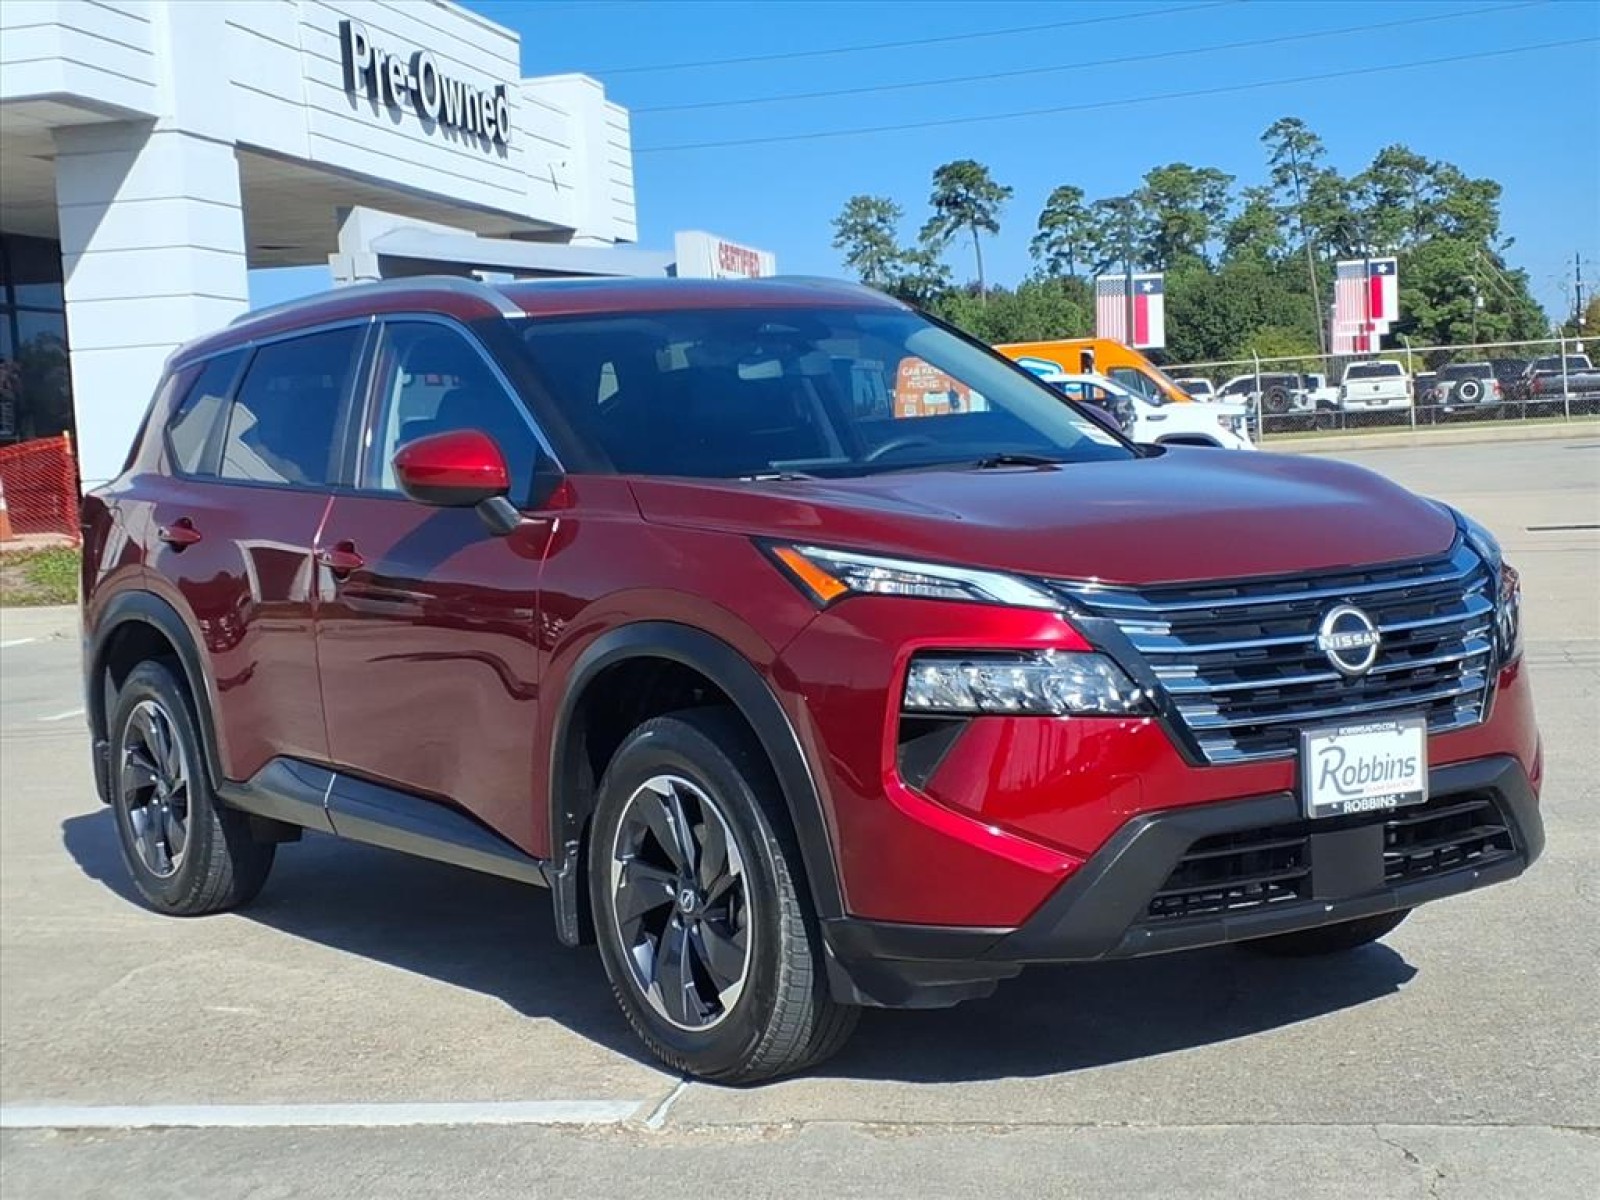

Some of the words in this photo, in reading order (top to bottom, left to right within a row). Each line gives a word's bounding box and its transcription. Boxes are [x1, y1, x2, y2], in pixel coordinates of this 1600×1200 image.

[339, 20, 511, 145] Pre-Owned
[719, 241, 759, 278] CERTIFIED
[1320, 631, 1380, 649] NISSAN
[1318, 746, 1416, 795] Robbins
[1343, 794, 1397, 813] ROBBINS
